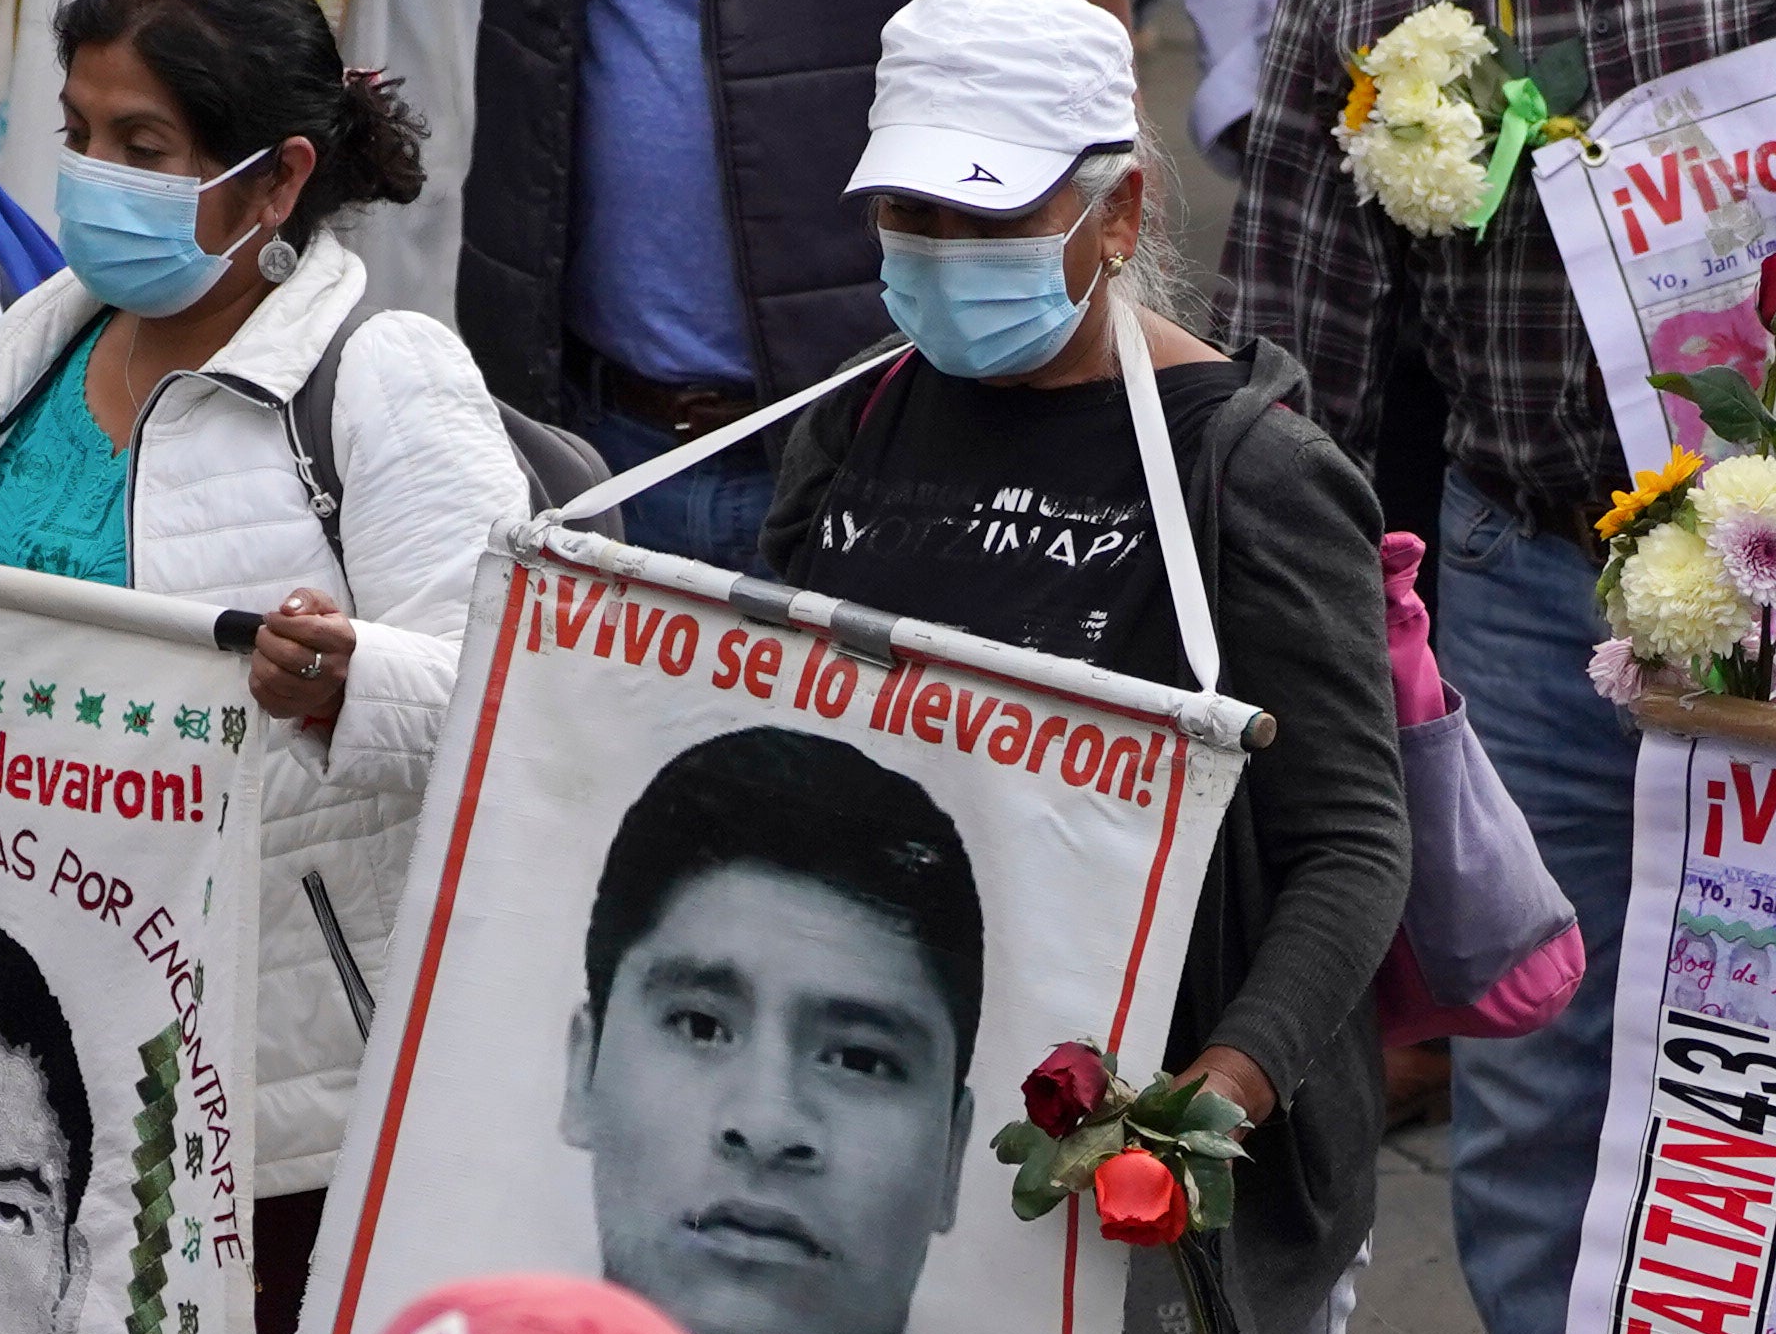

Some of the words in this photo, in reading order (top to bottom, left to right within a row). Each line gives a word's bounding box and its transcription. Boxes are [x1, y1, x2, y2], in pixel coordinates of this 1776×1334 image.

[1648, 272, 1689, 293] Yo,
[1702, 253, 1739, 278] Jan
[526, 574, 700, 678] ¡Vivo
[711, 629, 784, 700] se
[792, 637, 859, 720] lo
[869, 655, 1167, 808] llevaron!
[1697, 876, 1733, 909] Yo,
[48, 846, 134, 928] POR
[132, 905, 246, 1270] ENCONTRARTE
